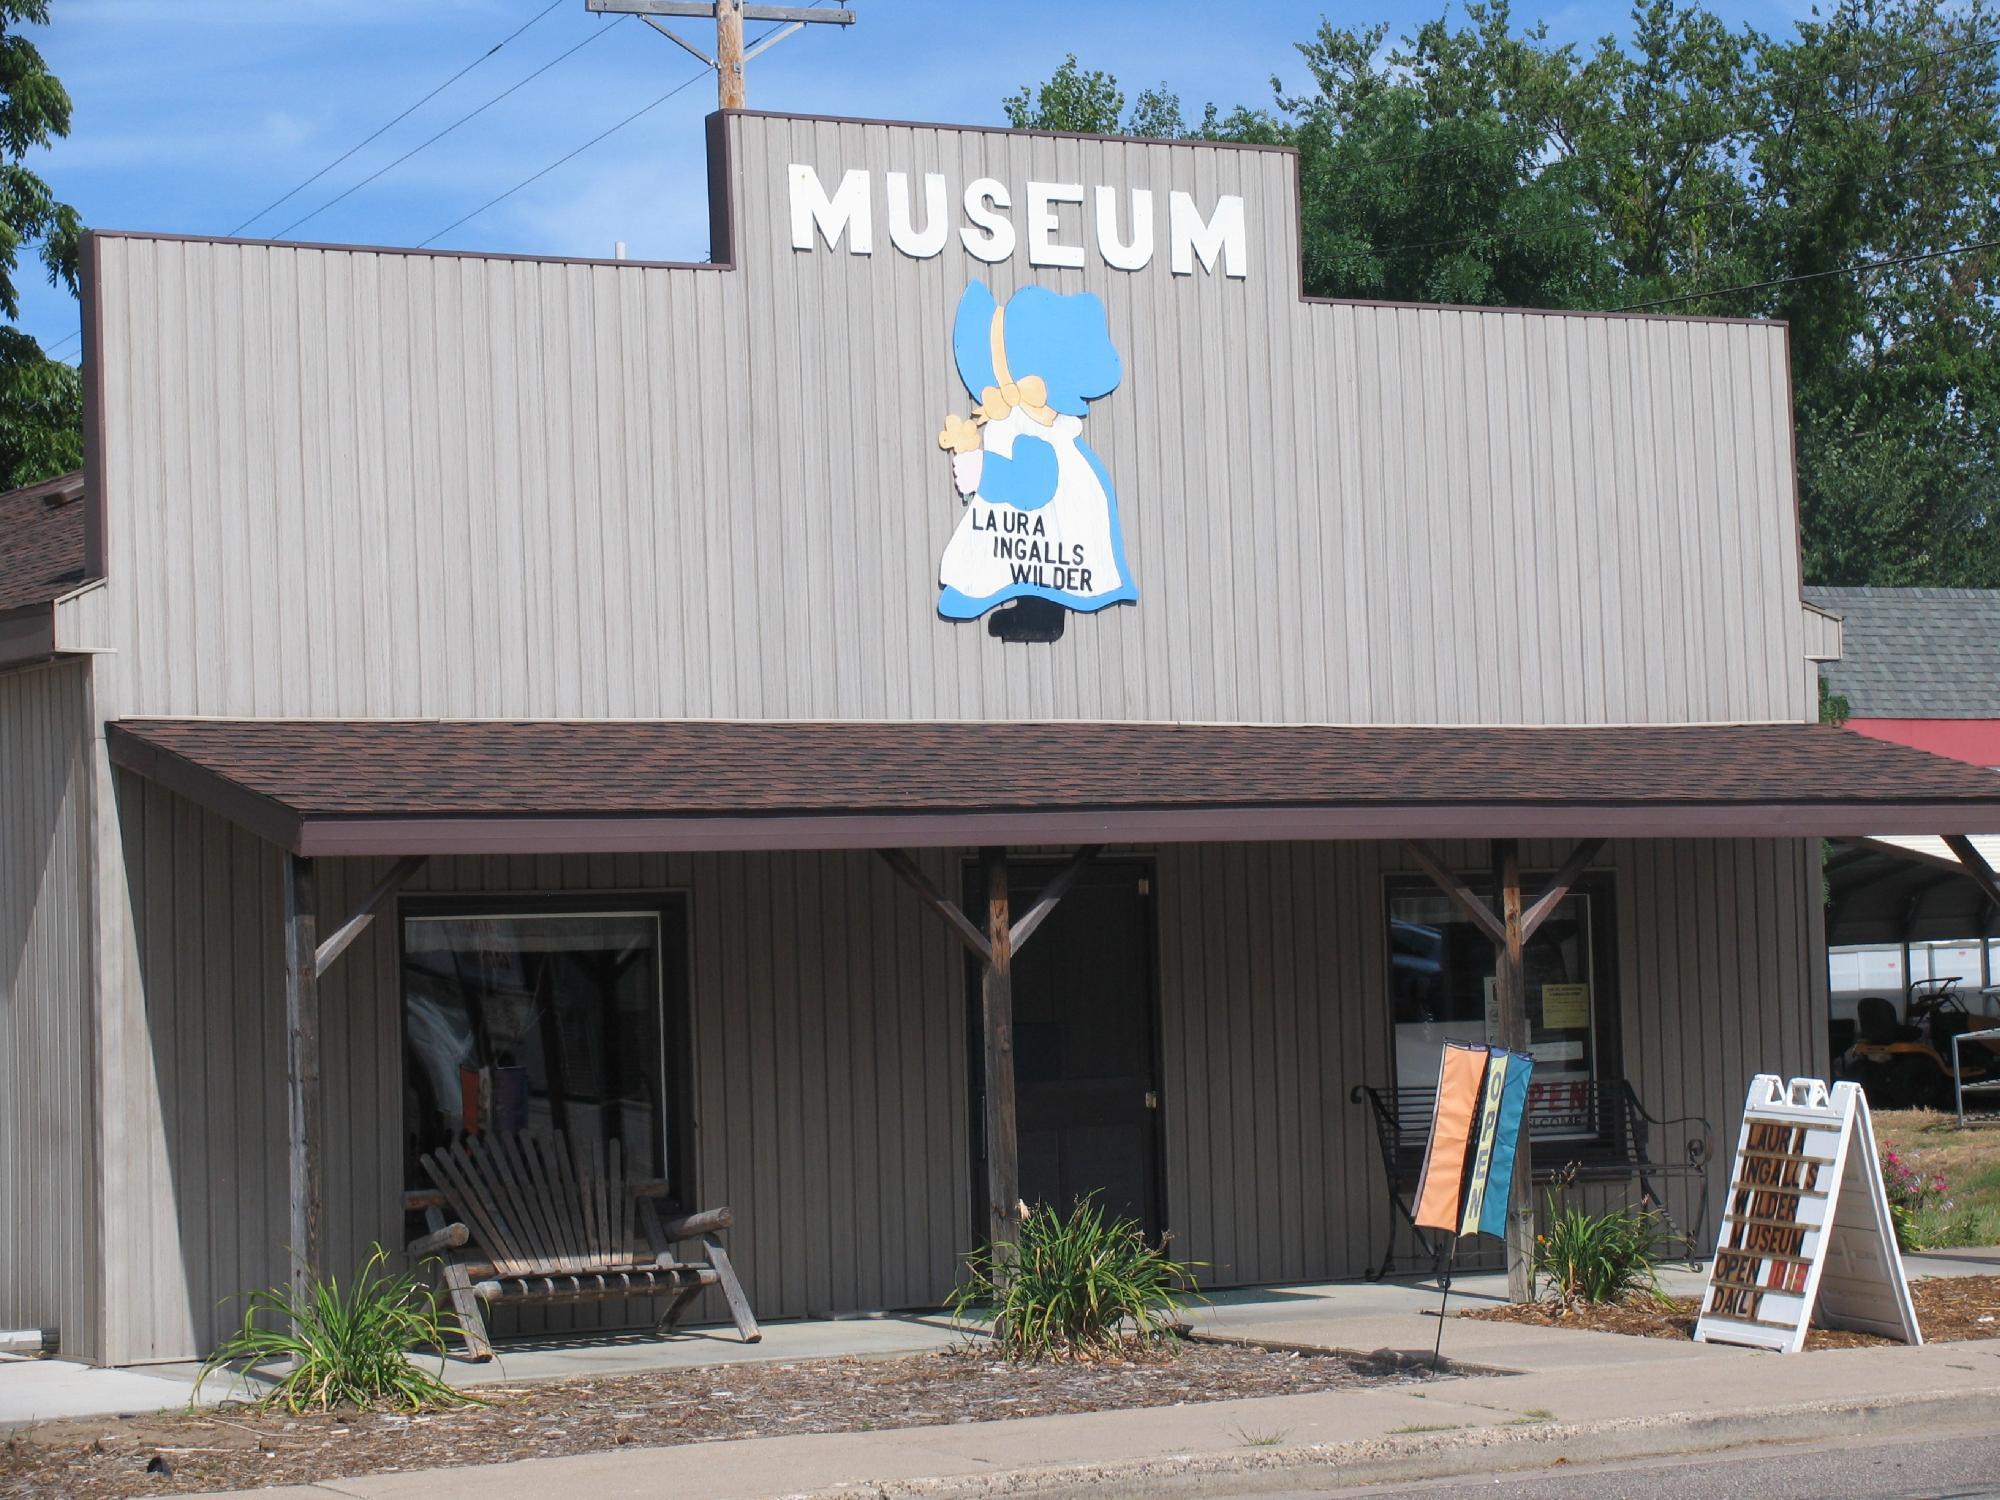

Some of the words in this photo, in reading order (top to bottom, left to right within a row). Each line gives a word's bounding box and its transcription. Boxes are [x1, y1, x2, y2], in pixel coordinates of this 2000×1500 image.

[788, 164, 1247, 278] MUSEUM
[972, 508, 1045, 537] LAURA
[993, 536, 1084, 566] INGALLS
[1010, 563, 1092, 592] WILDER
[1528, 1079, 1589, 1112] PEN
[1468, 1071, 1502, 1219] OPEN
[1746, 1123, 1806, 1154] LAURA
[1740, 1156, 1819, 1190] INGALLS
[1732, 1189, 1800, 1223] WILDER
[1728, 1221, 1804, 1257] MUSEUM
[1715, 1254, 1762, 1285] OPEN
[1709, 1286, 1763, 1319] DAILY
